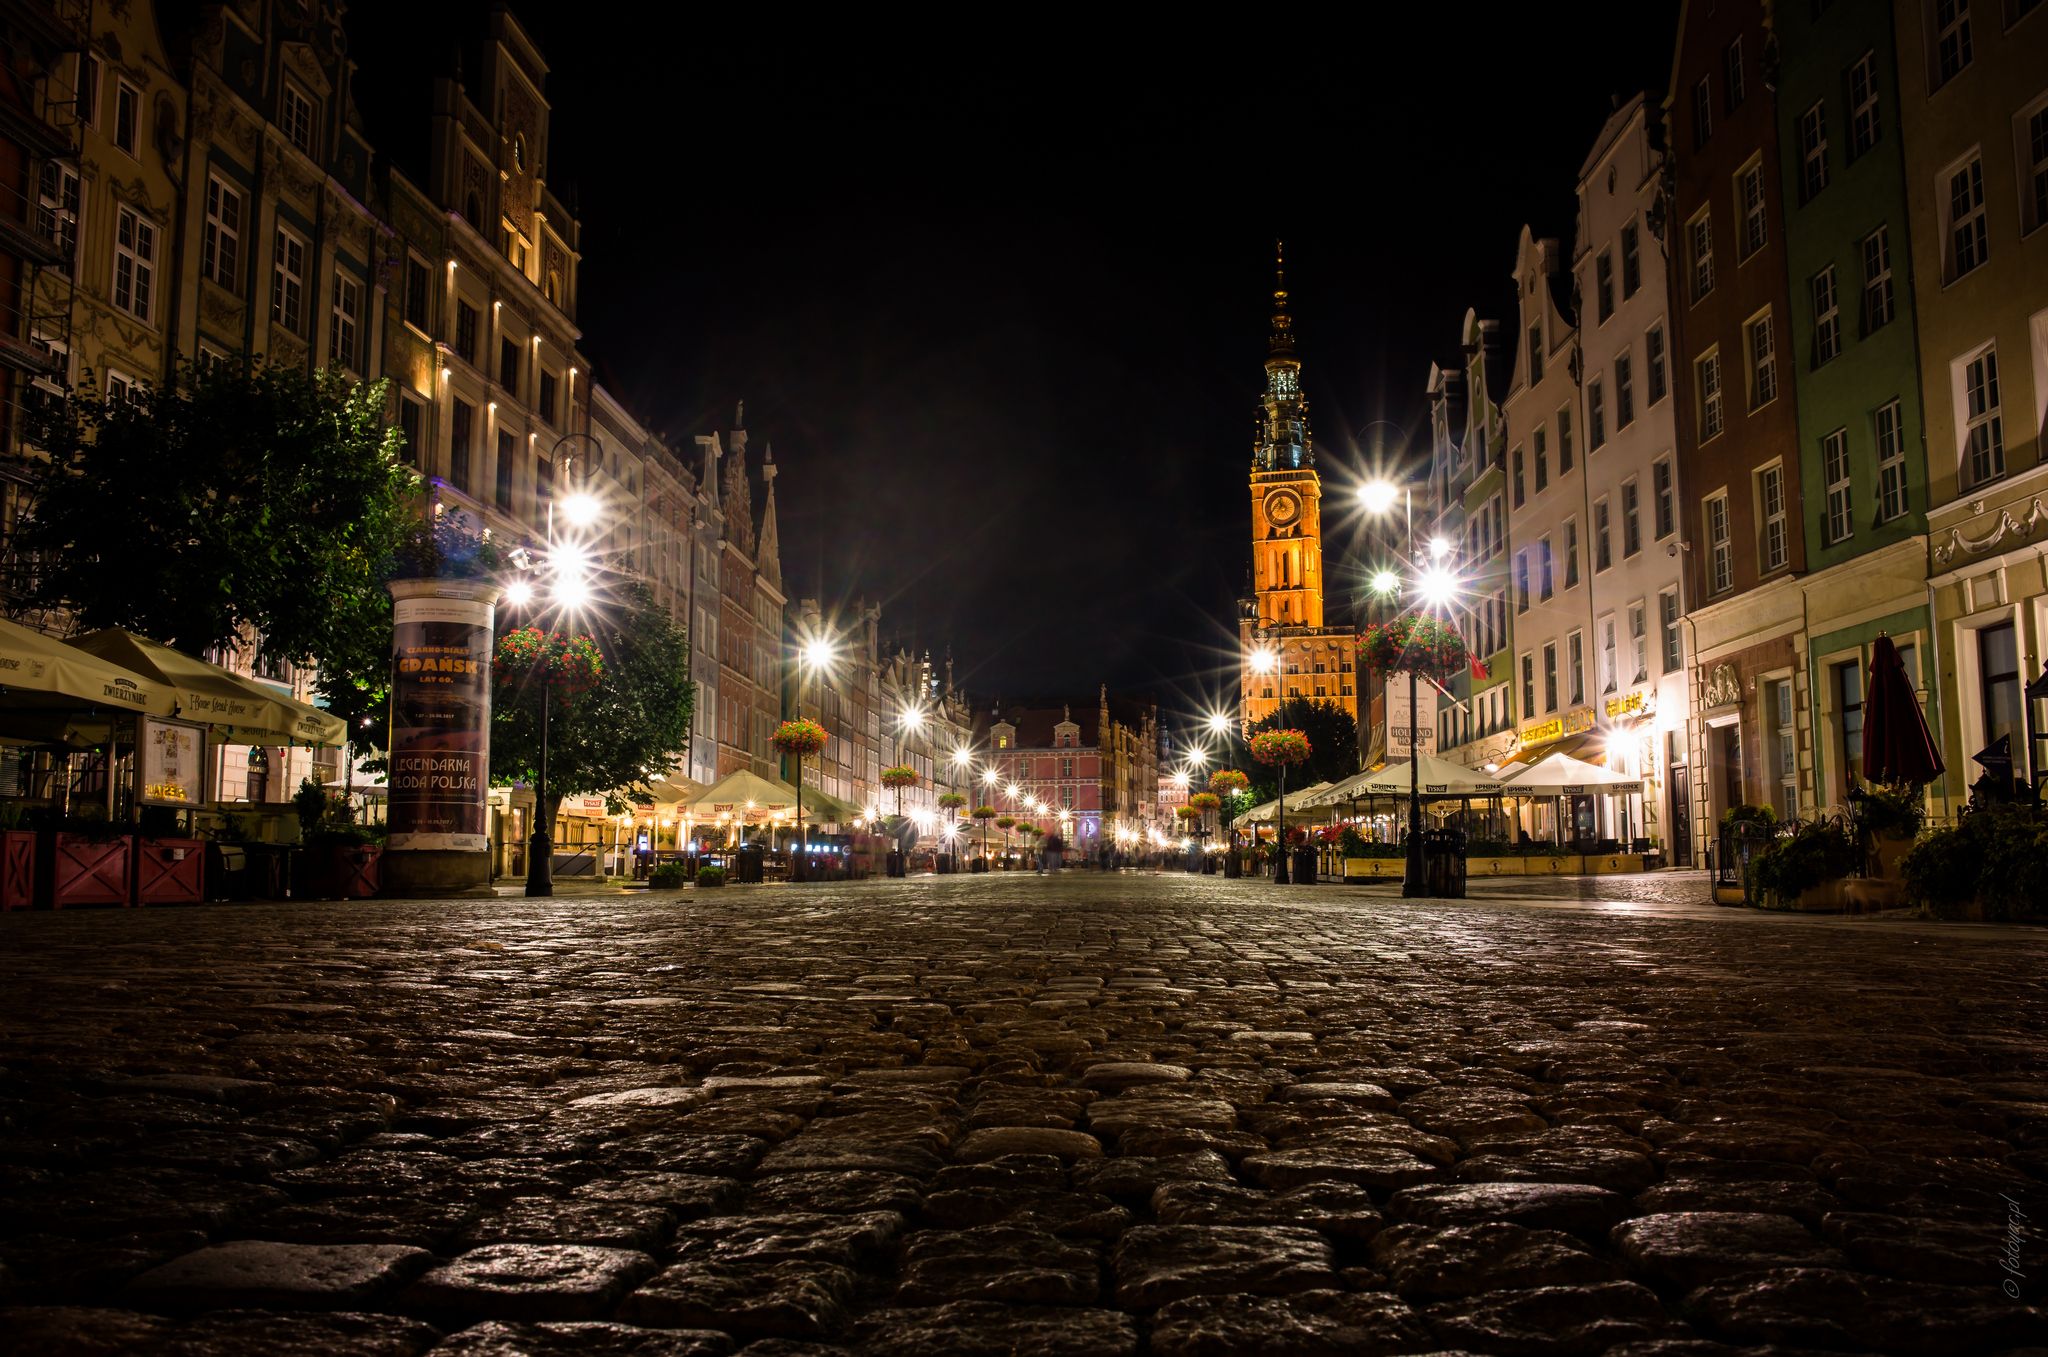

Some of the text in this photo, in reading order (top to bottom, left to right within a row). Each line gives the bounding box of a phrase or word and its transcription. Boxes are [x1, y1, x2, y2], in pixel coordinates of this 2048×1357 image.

[400, 656, 478, 673] GDAŃSK
[104, 684, 147, 705] ZWIERZYNIEC
[190, 694, 246, 715] T-Bone Steak House
[1392, 727, 1432, 737] HOLAND
[1400, 737, 1424, 745] HOSE
[395, 758, 470, 772] LEGENDARNA
[392, 775, 477, 789] MŁODA POLSKA
